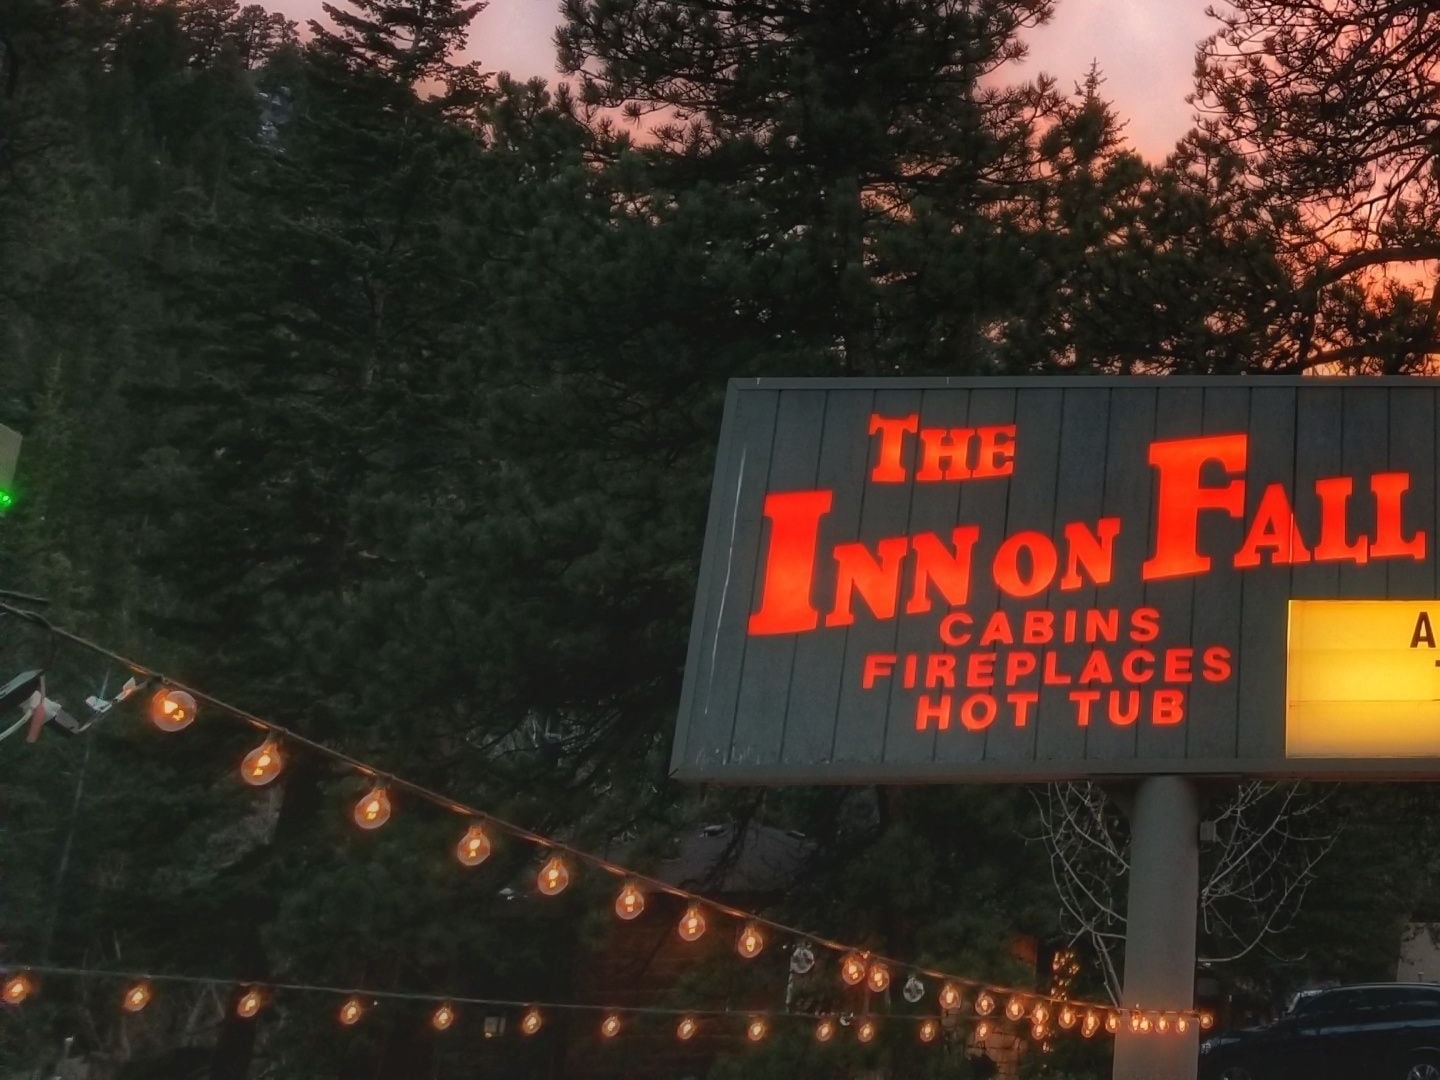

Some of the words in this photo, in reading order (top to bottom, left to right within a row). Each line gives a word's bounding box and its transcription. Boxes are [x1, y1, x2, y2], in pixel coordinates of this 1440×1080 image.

[868, 413, 1017, 484] THE
[747, 489, 980, 636] INN
[991, 517, 1121, 600] ON
[1141, 433, 1426, 581] FALL
[939, 607, 1160, 647] CABINS
[1410, 611, 1436, 649] A
[862, 646, 1232, 689] FIREPLACES
[915, 691, 1039, 732] HOT
[1068, 688, 1185, 727] TUB
